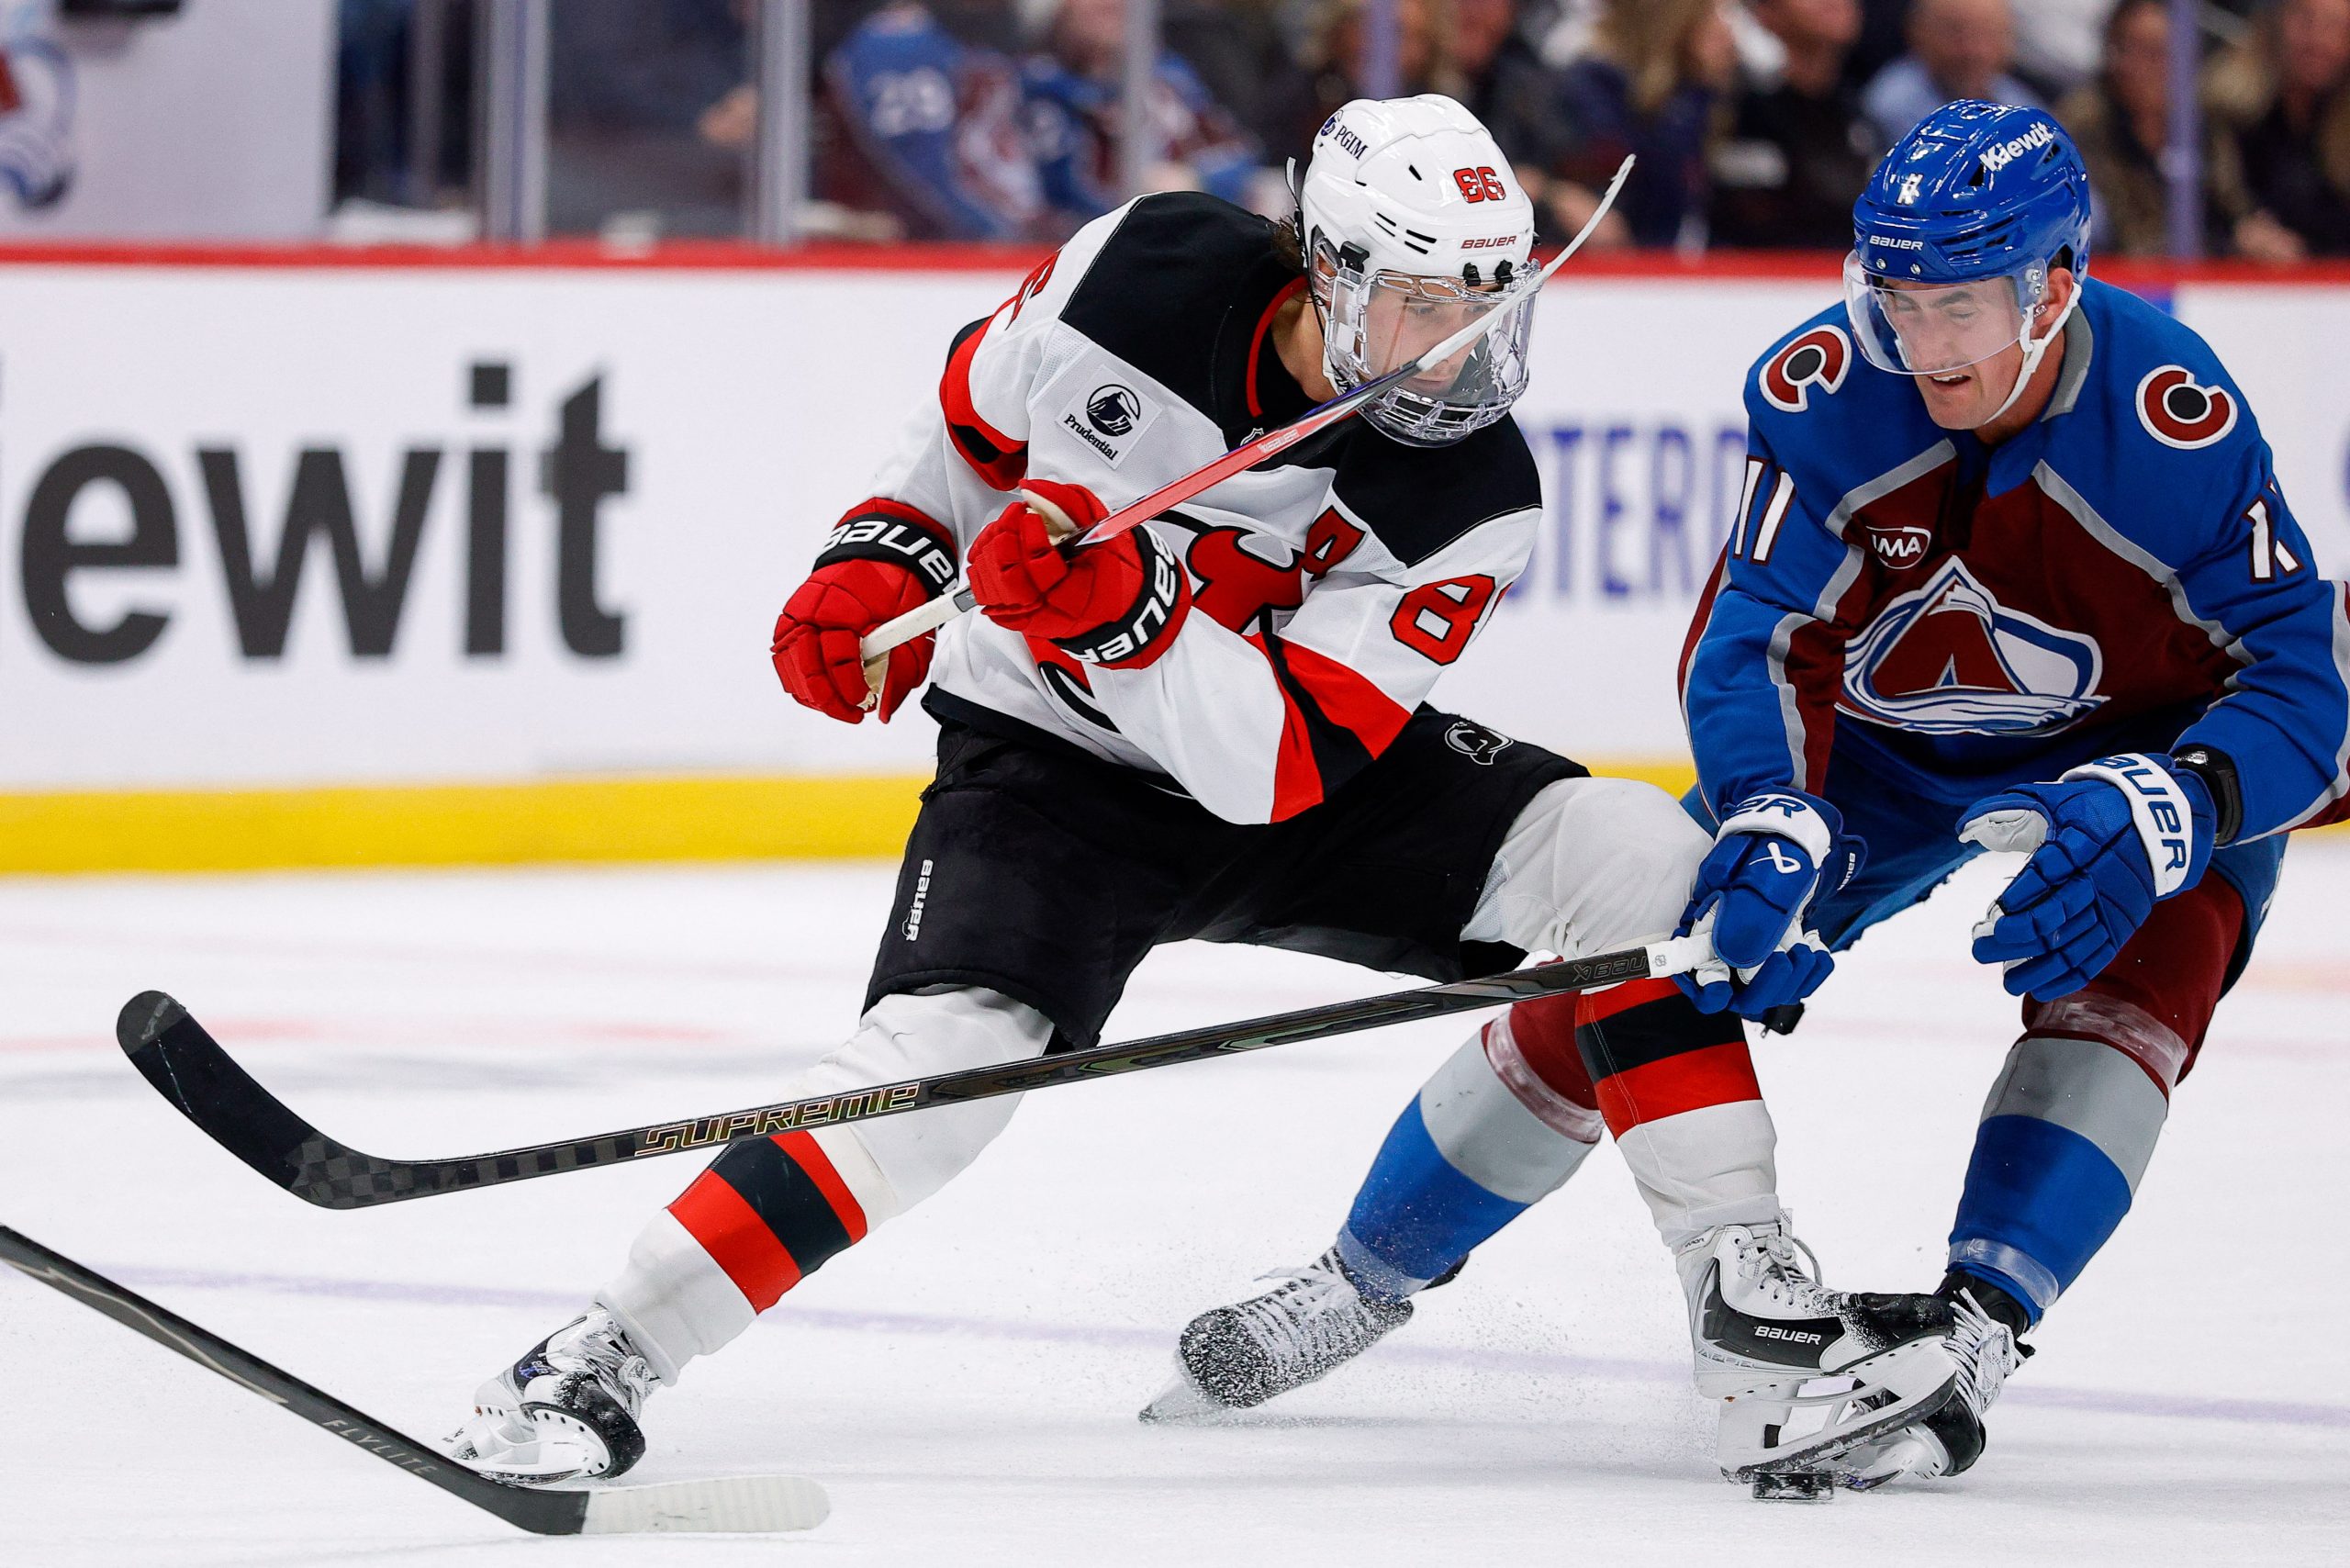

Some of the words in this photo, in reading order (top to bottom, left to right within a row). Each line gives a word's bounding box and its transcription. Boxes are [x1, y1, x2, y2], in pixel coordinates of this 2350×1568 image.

[1334, 125, 1369, 161] PGIM
[1978, 120, 2055, 173] Kiewit
[1453, 166, 1506, 204] 86
[1063, 413, 1119, 461] Prudential
[0, 353, 630, 666] ewit
[1730, 454, 1798, 566] 11
[1872, 535, 1922, 558] IMA
[1389, 573, 1513, 666] 8
[2093, 756, 2187, 873] AUER
[1593, 955, 1650, 980] BAU
[633, 1082, 920, 1158] SUPREME
[322, 1419, 438, 1473] FLYLITE
